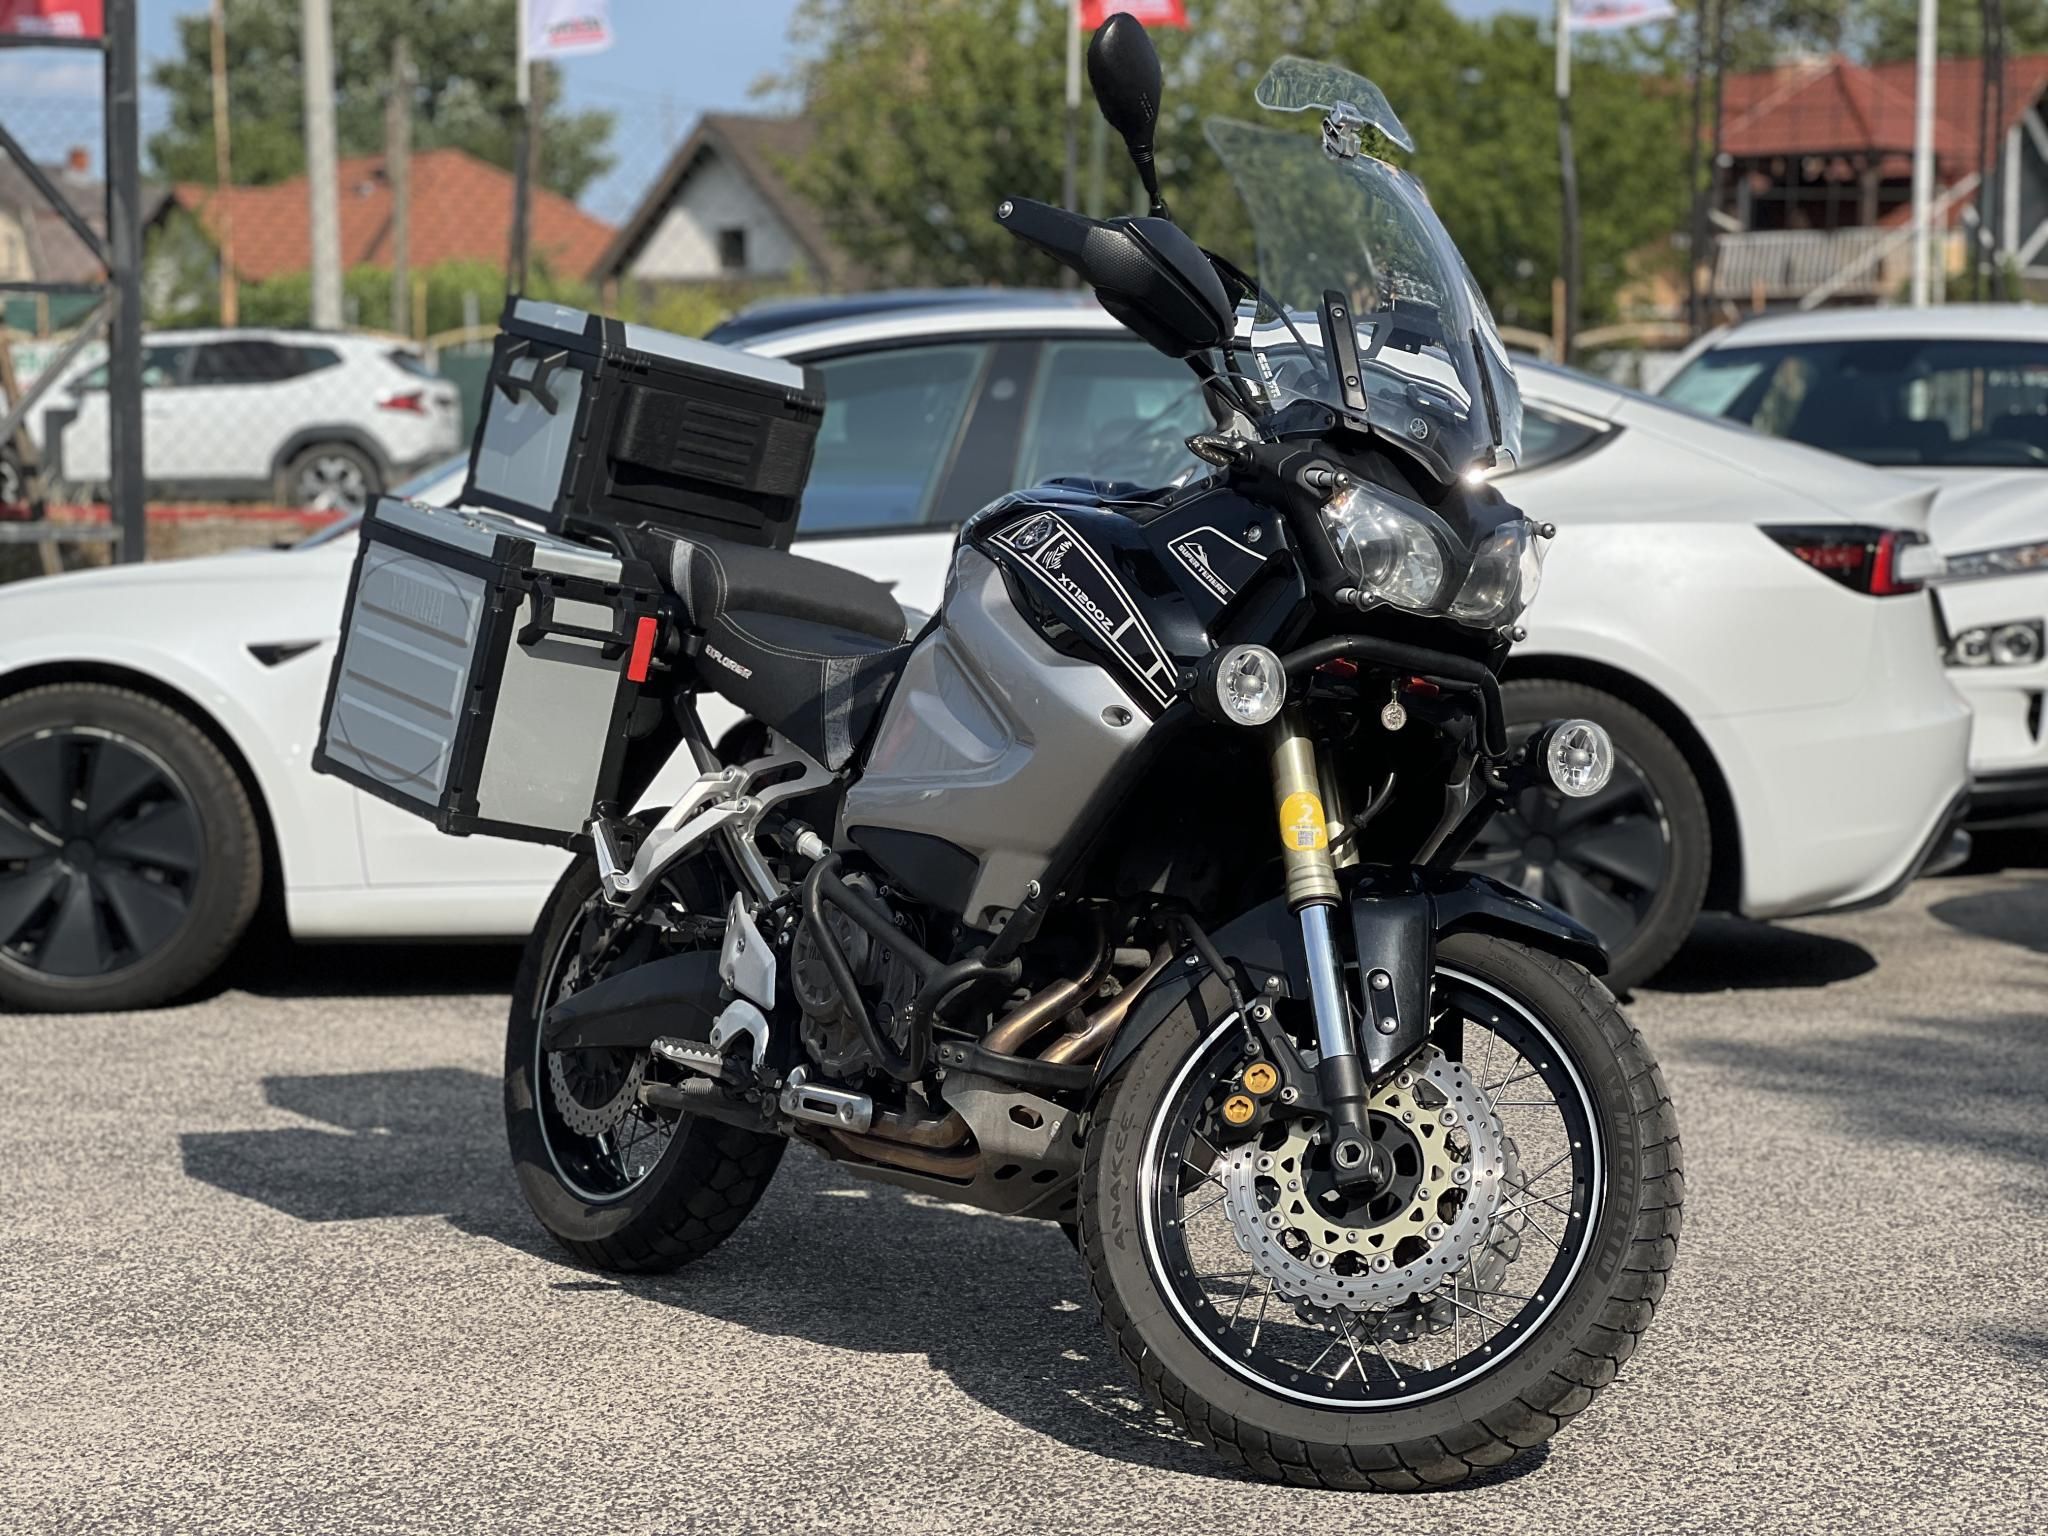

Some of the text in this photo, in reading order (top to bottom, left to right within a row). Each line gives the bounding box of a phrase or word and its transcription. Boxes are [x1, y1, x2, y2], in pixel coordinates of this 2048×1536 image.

[1178, 544, 1200, 568] SUPER
[1058, 573, 1114, 631] XT1200Z
[705, 644, 752, 679] EXPLORER
[1297, 804, 1313, 823] 2
[1110, 1111, 1135, 1251] ANAKEE
[1602, 1112, 1634, 1269] MICHELIN
